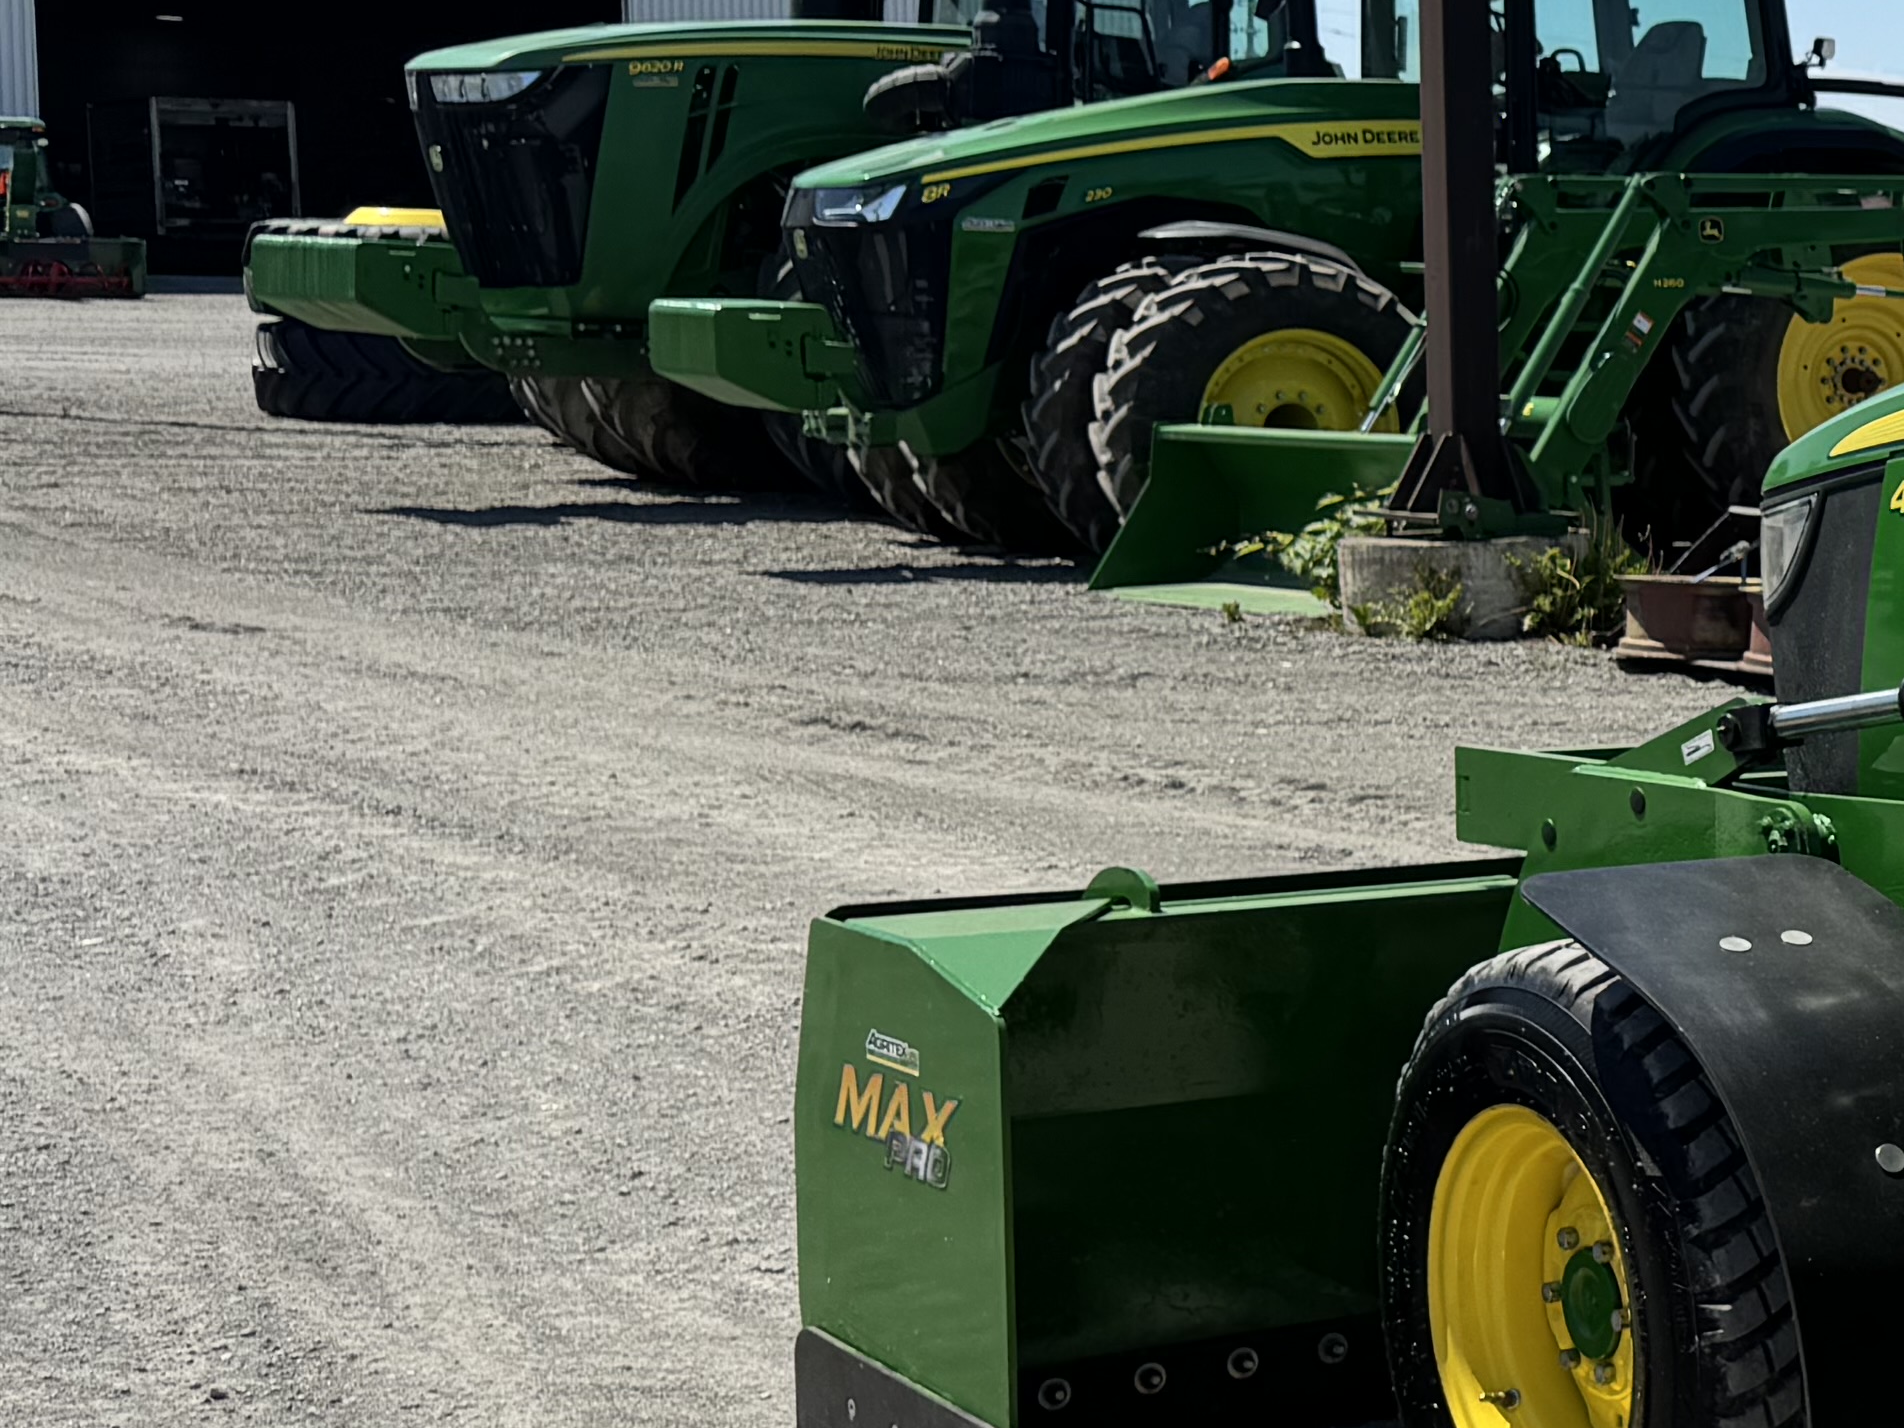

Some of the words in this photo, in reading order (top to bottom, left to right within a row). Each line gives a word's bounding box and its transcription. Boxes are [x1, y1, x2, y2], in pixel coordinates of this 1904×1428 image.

[1312, 130, 1359, 146] JOHN
[1361, 128, 1420, 145] DEERE
[921, 183, 951, 203] 8R
[834, 1063, 959, 1148] MAX
[884, 1127, 951, 1190] PRO
